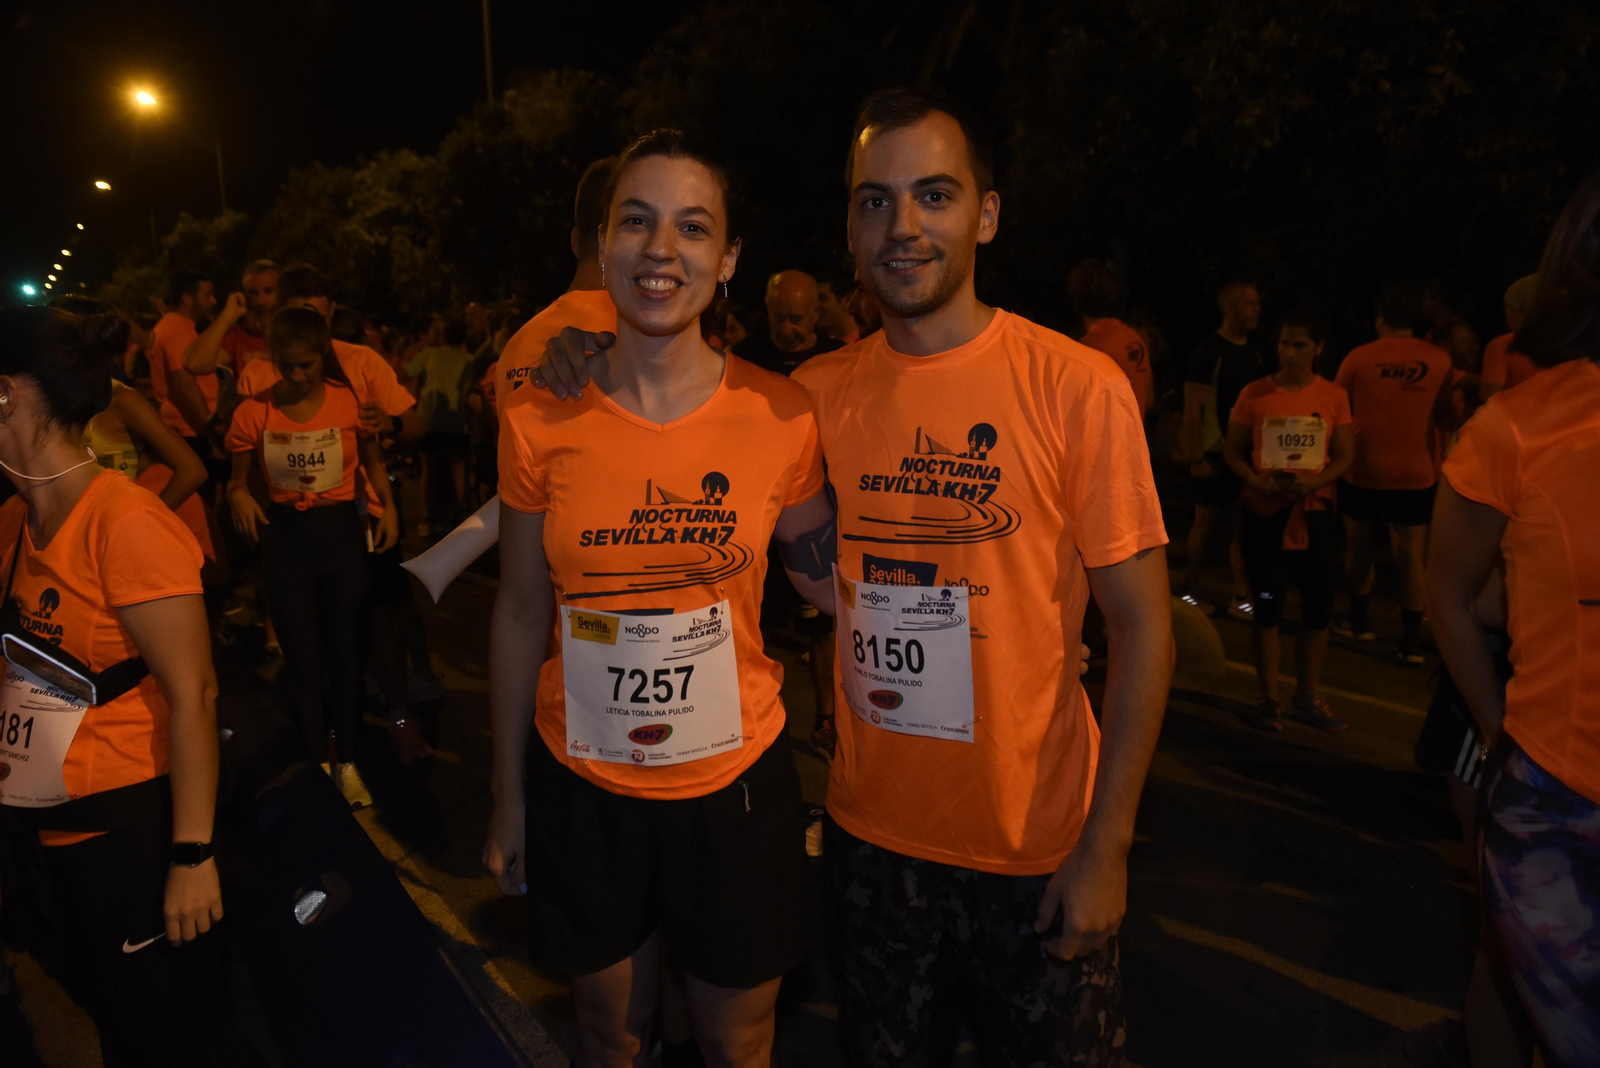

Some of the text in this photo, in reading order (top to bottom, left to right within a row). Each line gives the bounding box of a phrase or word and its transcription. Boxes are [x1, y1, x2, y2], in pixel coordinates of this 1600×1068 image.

[506, 366, 533, 380] NOCT
[1278, 434, 1315, 447] 10923
[287, 451, 325, 468] 9844
[900, 457, 1001, 482] NOCTURNA
[859, 474, 939, 497] SEVILLA
[629, 508, 737, 524] NOCTURNA
[579, 527, 675, 547] SEVILLA
[901, 607, 935, 615] SEVILLA
[20, 619, 63, 636] TURNA
[688, 619, 722, 633] NOCTURNA
[672, 630, 705, 643] SEVILLA
[853, 629, 925, 674] 8150
[608, 665, 694, 703] 7257
[868, 673, 897, 685] TOBALINA
[898, 678, 923, 688] PULIDO
[606, 705, 695, 718] LETICIA TOBALINA PULIDO
